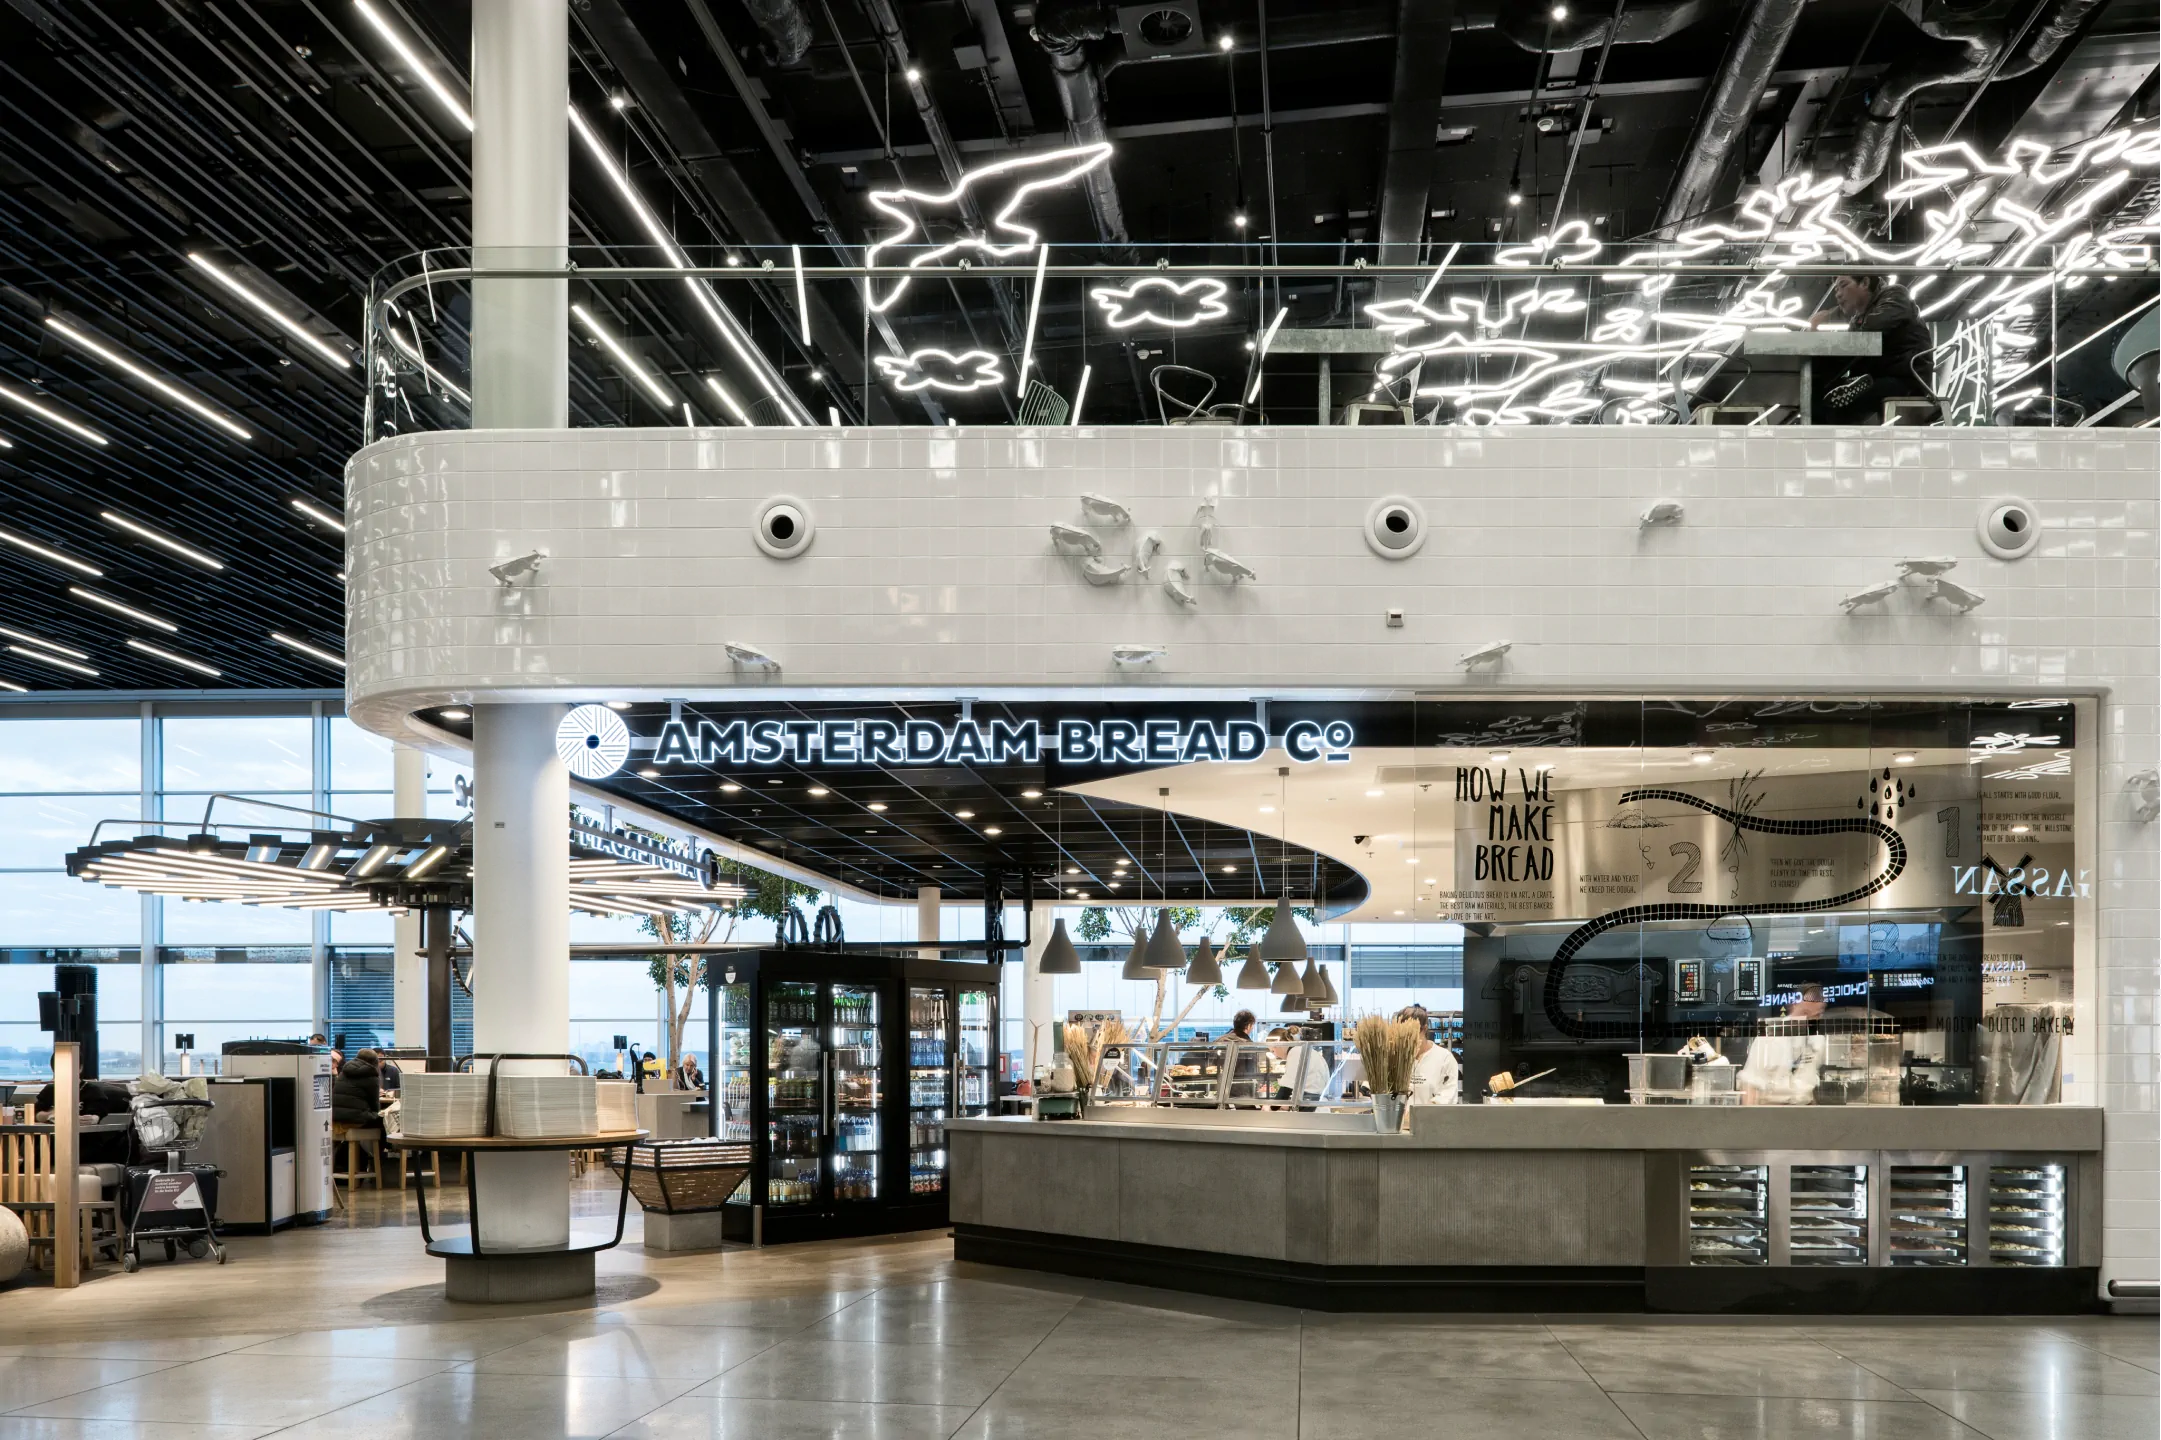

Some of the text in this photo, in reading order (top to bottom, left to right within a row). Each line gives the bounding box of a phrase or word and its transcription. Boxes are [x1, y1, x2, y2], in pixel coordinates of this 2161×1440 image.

[653, 720, 1039, 763] AMSTERDAM
[1058, 720, 1268, 763] BREAD
[1456, 766, 1556, 802] HOW WE
[1994, 791, 2013, 800] STARTS
[2014, 791, 2027, 800] WITH
[2028, 791, 2041, 800] GOOD
[1996, 813, 2018, 821] RESPECT
[1489, 804, 1555, 842] MAKE
[1937, 806, 1961, 858] 1
[2000, 824, 2009, 832] THE
[2044, 824, 2073, 832] MILLSTONE
[1983, 835, 1996, 843] PART
[1475, 845, 1554, 882] BREAD
[1668, 841, 1703, 894] 2
[1580, 875, 1639, 883] WITH WATER AND YEAST
[1580, 886, 1637, 894] WE KNEED THE DOUGH.
[1440, 891, 1458, 899] BAKING
[1458, 891, 1485, 899] DELICIOUS
[1486, 891, 1502, 899] BREAD
[1510, 891, 1517, 899] AN
[1518, 891, 1530, 899] ART.
[1531, 891, 1536, 899] A
[1537, 891, 1555, 899] CRAFT.
[1440, 902, 1554, 910] THE BEST RAW MATERIALS, THE BEST BAKERS
[1451, 913, 1464, 921] LOVE
[1465, 913, 1472, 921] OF
[1473, 913, 1482, 921] THE
[1483, 913, 1496, 921] ART.
[2002, 953, 2008, 962] TO
[1936, 1016, 2076, 1034] MODERN DUTCH BAKERY
